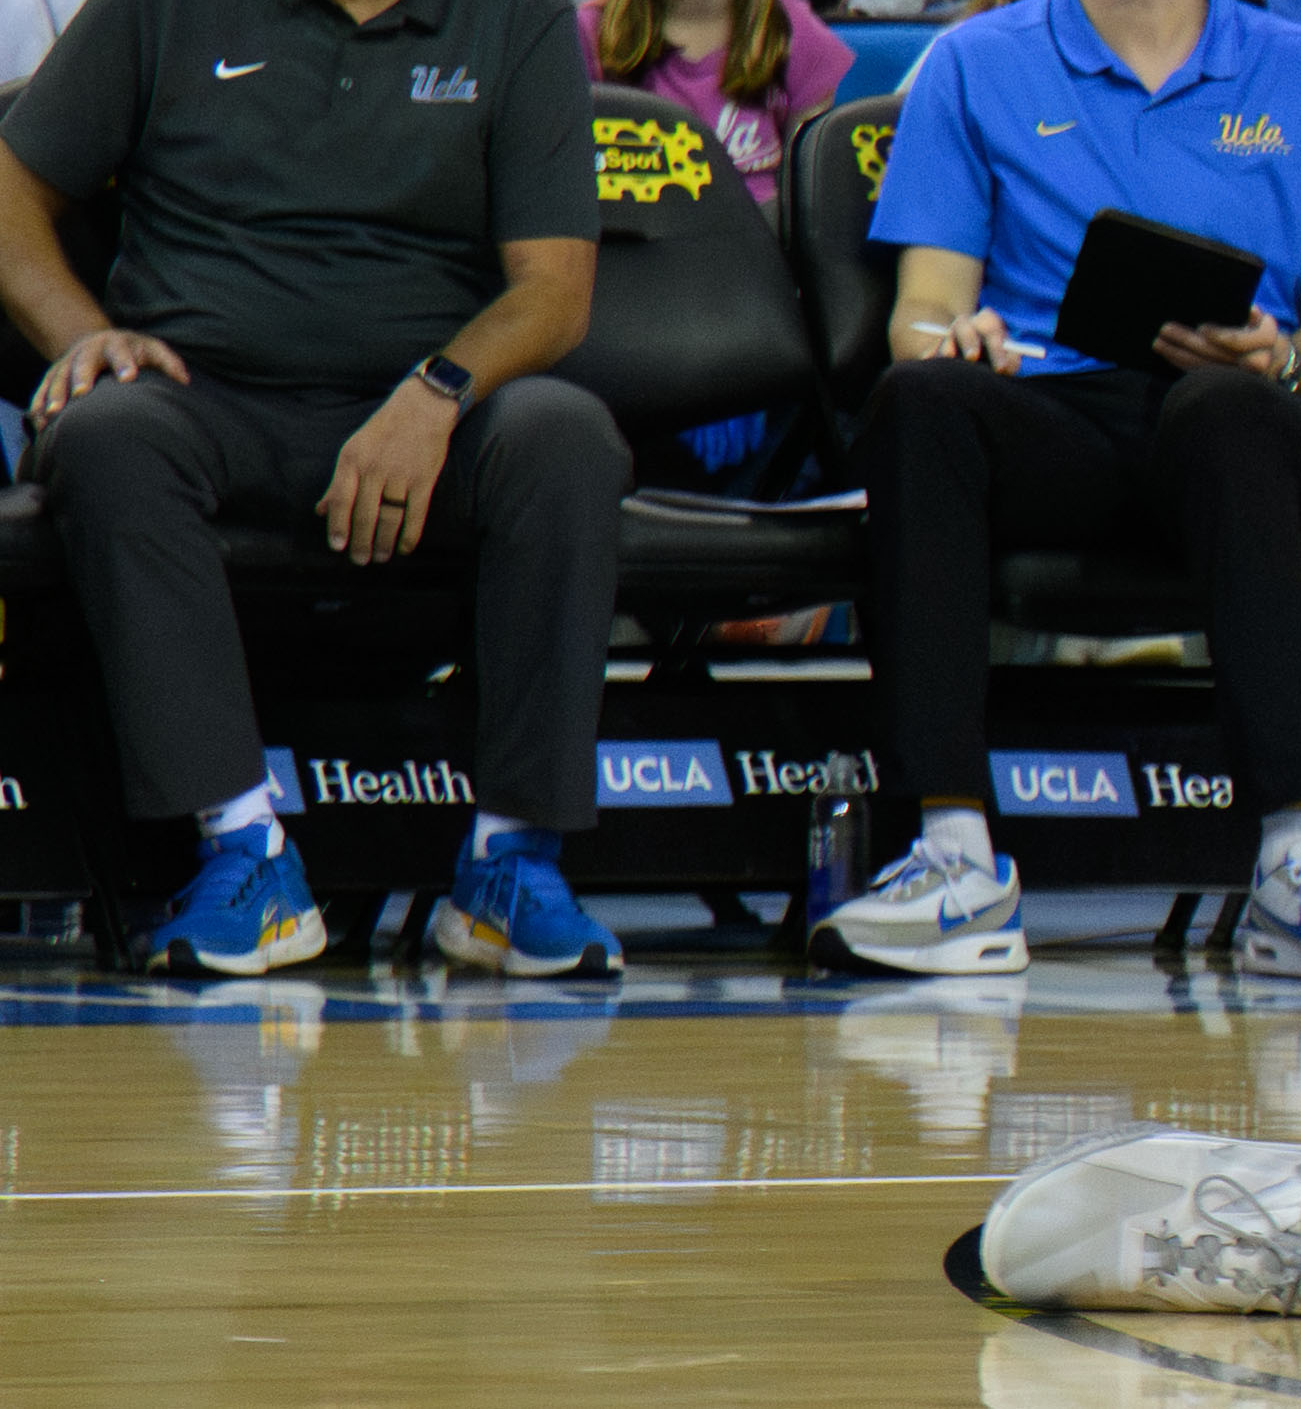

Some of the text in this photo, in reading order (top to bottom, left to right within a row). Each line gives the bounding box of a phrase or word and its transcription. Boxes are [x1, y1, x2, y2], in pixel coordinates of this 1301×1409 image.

[1219, 113, 1284, 146] Ucla
[310, 758, 476, 805] Health
[602, 757, 713, 793] UCLA
[1011, 766, 1119, 803] UCLA
